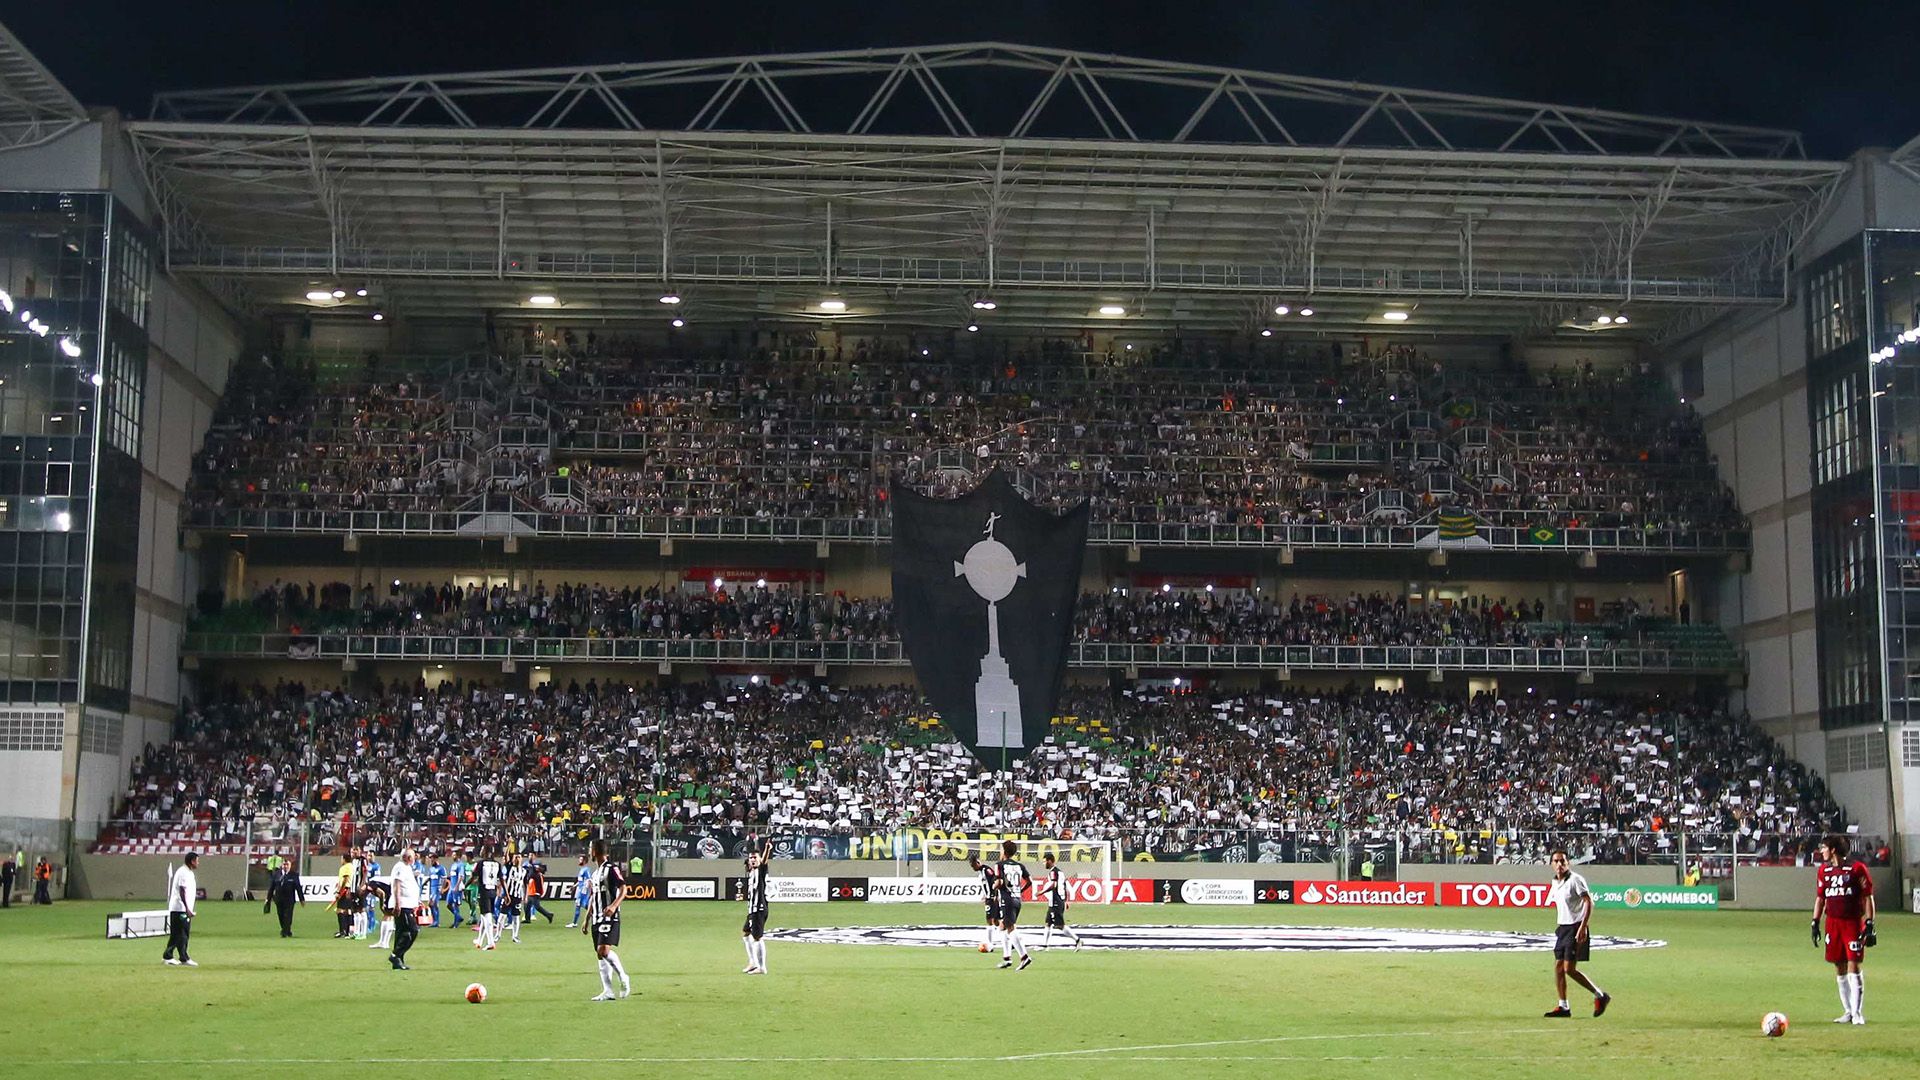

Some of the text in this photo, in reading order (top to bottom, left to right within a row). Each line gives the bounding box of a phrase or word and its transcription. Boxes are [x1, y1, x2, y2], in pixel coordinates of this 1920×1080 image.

[1830, 874, 1844, 888] 24
[684, 885, 711, 894] Curtir
[831, 884, 865, 898] 2016
[869, 884, 914, 896] PNEUS
[1257, 887, 1290, 900] 2016
[1325, 884, 1426, 905] Santander
[1643, 892, 1716, 905] CONMEBOL
